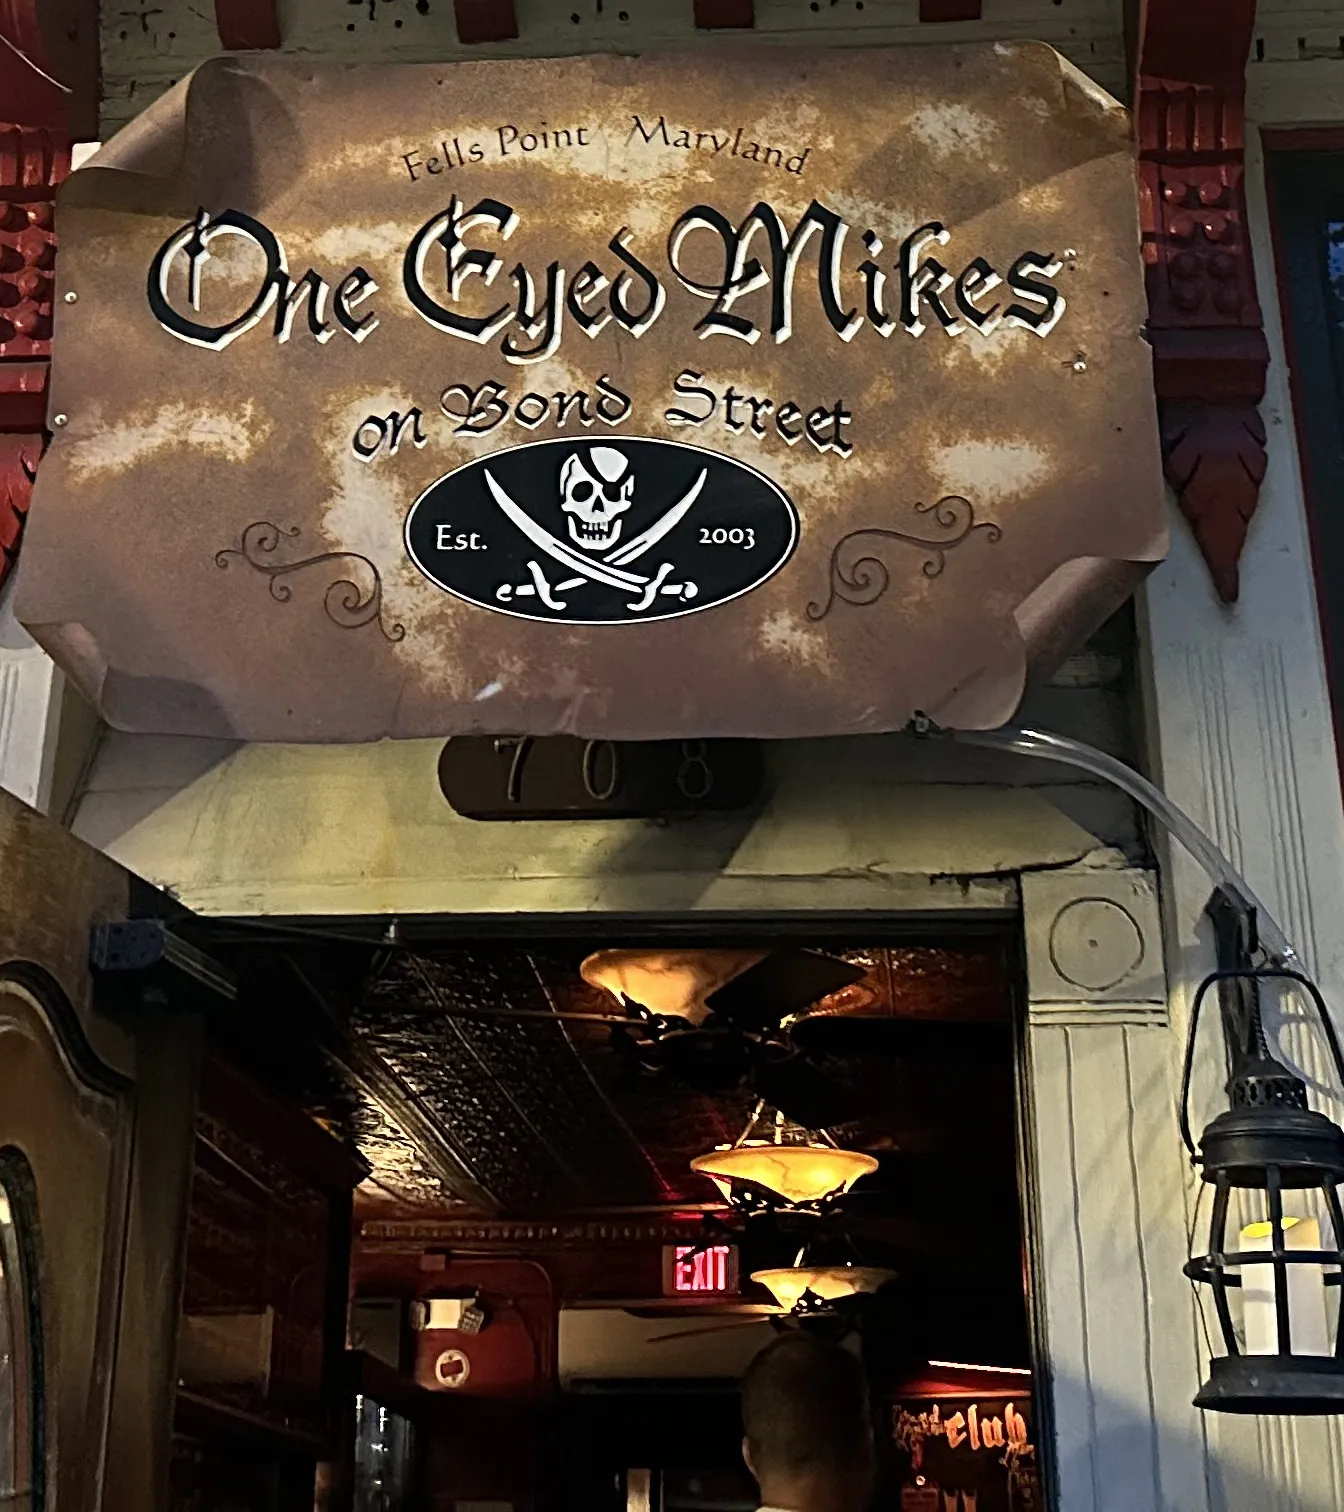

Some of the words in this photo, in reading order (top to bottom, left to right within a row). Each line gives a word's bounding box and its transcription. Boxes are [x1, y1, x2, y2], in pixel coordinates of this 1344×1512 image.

[401, 137, 485, 182] Fells
[496, 121, 589, 157] Point
[625, 115, 813, 176] Maryland
[147, 205, 380, 351] One
[403, 193, 667, 366] Eyed
[667, 199, 1067, 345] Mikes
[352, 406, 428, 464] on
[440, 373, 633, 438] Bond
[664, 368, 854, 459] Street
[435, 523, 489, 551] Est.
[699, 526, 756, 550] 2003
[675, 1245, 730, 1291] EXIT
